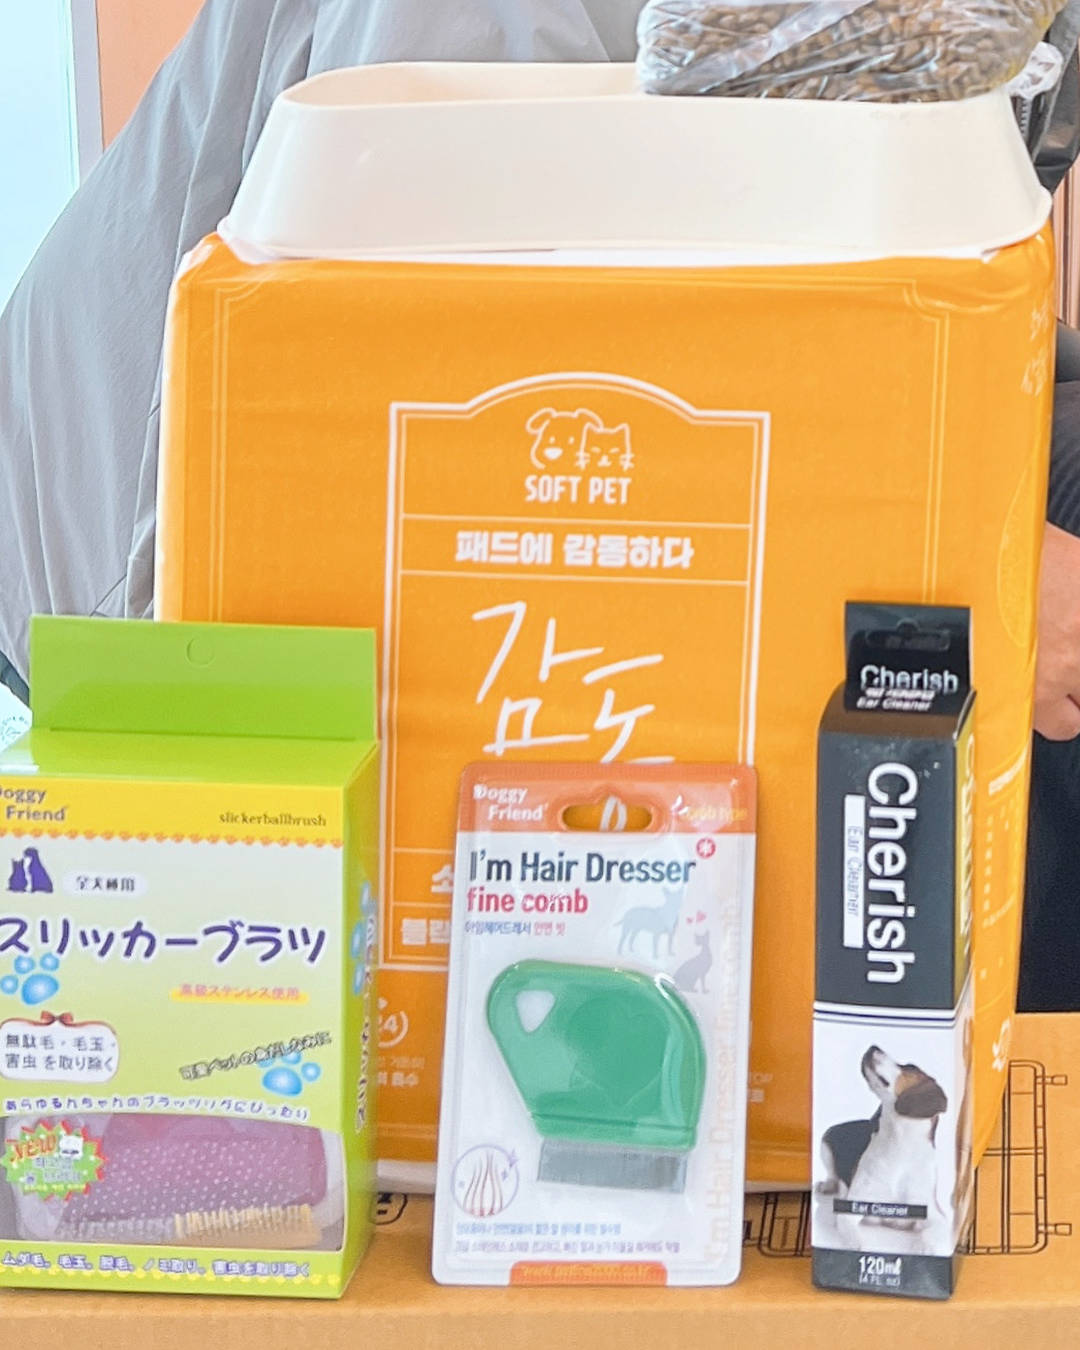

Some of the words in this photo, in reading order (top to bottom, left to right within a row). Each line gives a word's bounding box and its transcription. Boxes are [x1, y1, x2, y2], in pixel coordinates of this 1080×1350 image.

[525, 475, 581, 502] SOFT
[588, 476, 632, 504] PET
[455, 530, 553, 565] 패드에
[563, 534, 694, 569] 감동하다
[860, 664, 958, 696] Cherish
[0, 787, 47, 804] oggy
[473, 783, 528, 805] Doggy
[6, 805, 68, 821] Friend
[219, 811, 327, 827] slickerballbrush
[488, 803, 544, 821] Friend
[469, 850, 512, 883] I'm
[520, 851, 579, 883] Hair
[585, 852, 697, 884] Dresser
[867, 762, 918, 983] Cherish
[467, 886, 515, 913] fine
[521, 887, 589, 914] comb
